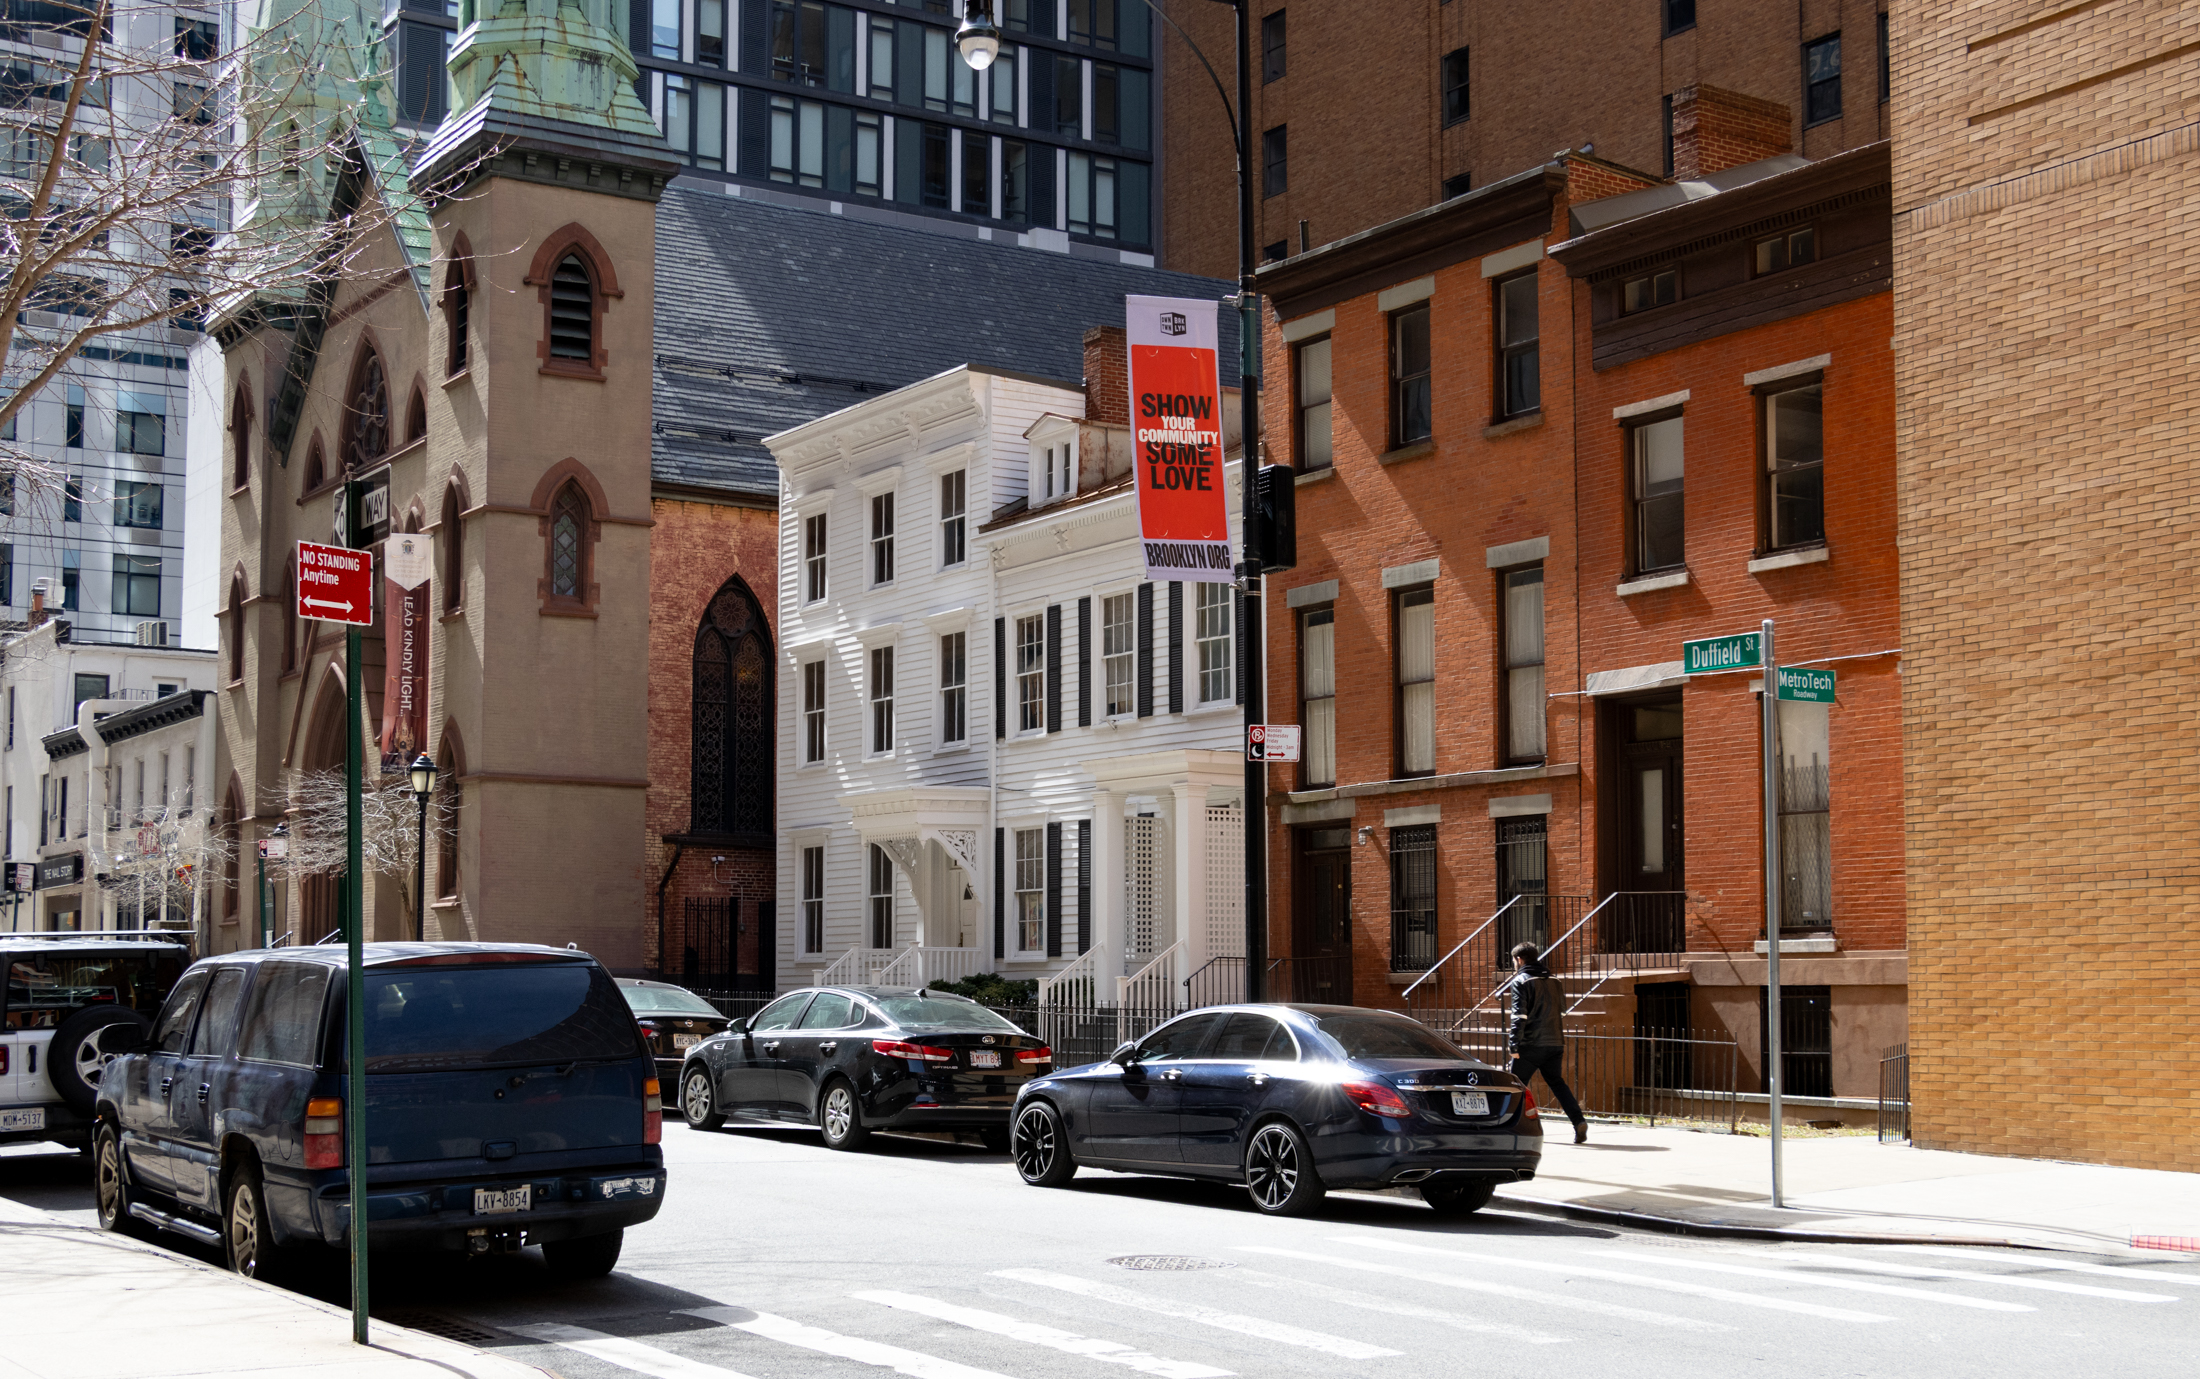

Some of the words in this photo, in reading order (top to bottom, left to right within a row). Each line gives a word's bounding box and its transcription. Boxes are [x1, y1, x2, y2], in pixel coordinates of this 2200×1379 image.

[1141, 393, 1212, 419] SHOW
[1161, 416, 1195, 431] YOUR
[1138, 428, 1218, 445] COMMUNITY
[1146, 441, 1214, 466] SOME
[1150, 465, 1212, 491] LOVE
[365, 491, 385, 524] WAY
[302, 550, 315, 565] NO
[317, 553, 360, 571] STANDING
[1144, 543, 1207, 569] BROOKLYN
[1206, 545, 1231, 570] ORG
[303, 568, 339, 585] Anytime
[404, 596, 413, 627] LEAD
[403, 630, 413, 674] KINDLY
[1692, 640, 1741, 669] Duffield
[1745, 637, 1754, 651] St
[1779, 671, 1832, 690] MetroTech
[400, 676, 413, 717] LIGHT...
[1793, 689, 1818, 700] Roadway
[44, 868, 52, 880] THE
[52, 867, 60, 879] NAIL
[60, 864, 74, 877] STORY
